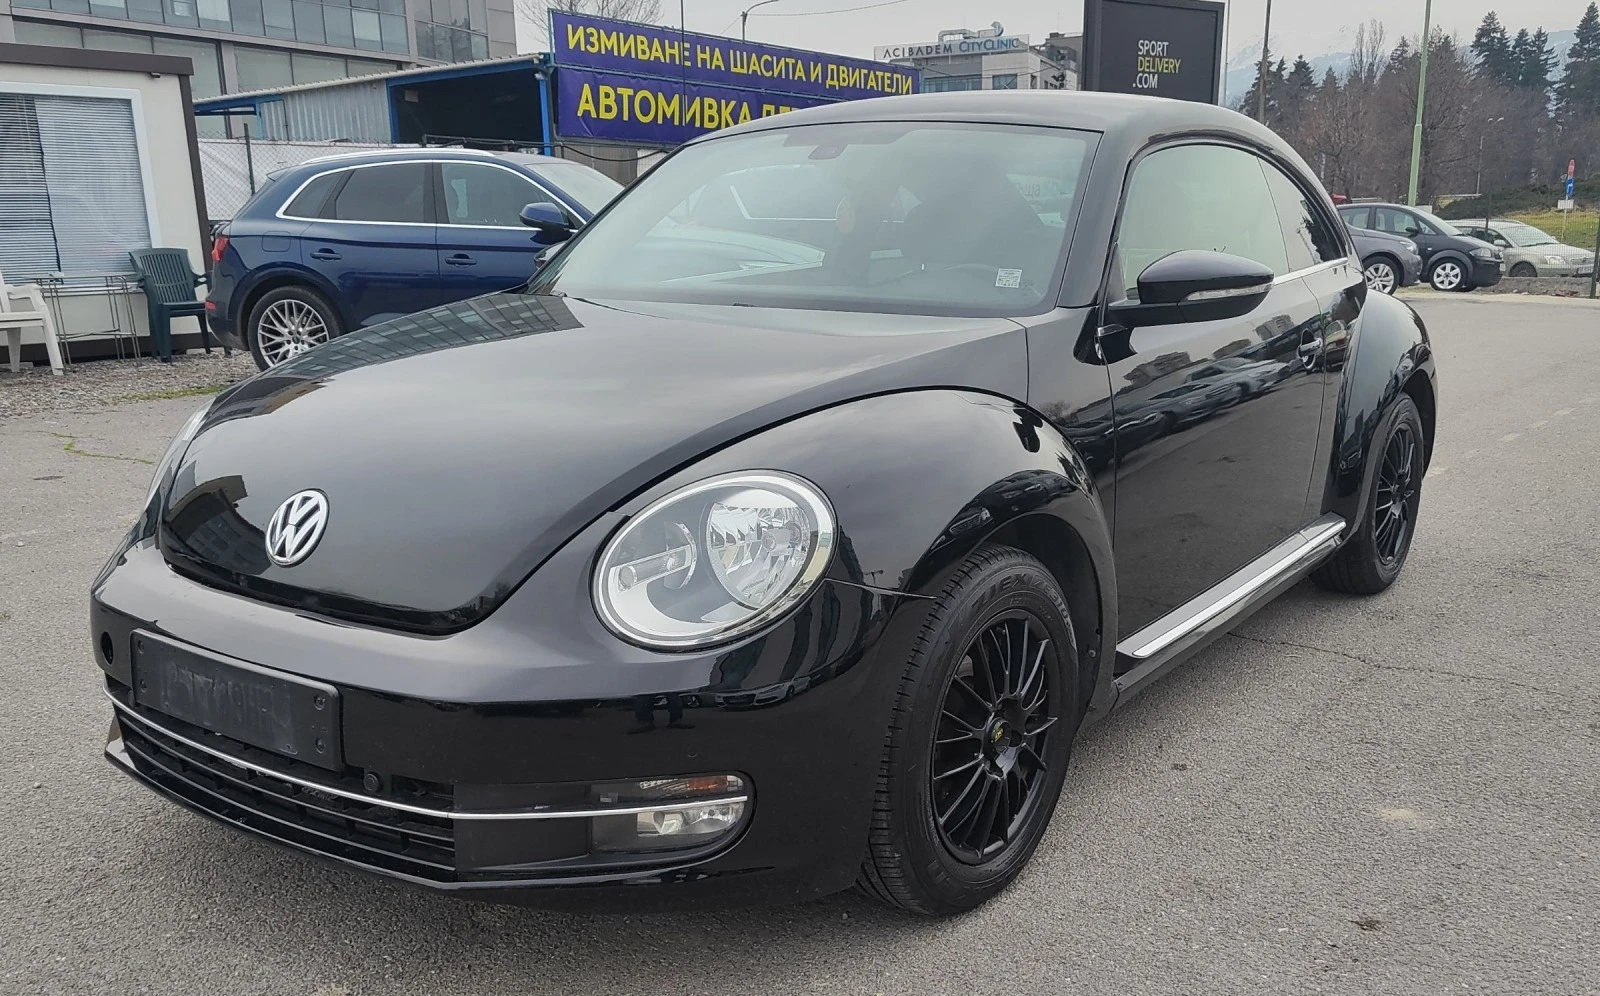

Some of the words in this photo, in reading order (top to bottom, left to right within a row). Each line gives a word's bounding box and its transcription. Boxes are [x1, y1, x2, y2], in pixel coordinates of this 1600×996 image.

[883, 44, 953, 59] ACIBADEM
[1137, 39, 1169, 57] SPORT
[567, 23, 692, 67] ИЗМИВАНЕ
[696, 44, 725, 71] НА
[729, 49, 806, 82] ШАСИТА
[810, 61, 822, 84] И
[825, 63, 912, 95] ДВИГАТЕЛИ
[1137, 56, 1181, 74] DELIVERY
[1132, 72, 1158, 89] .COM
[576, 83, 752, 130] АВТОМИВКА
